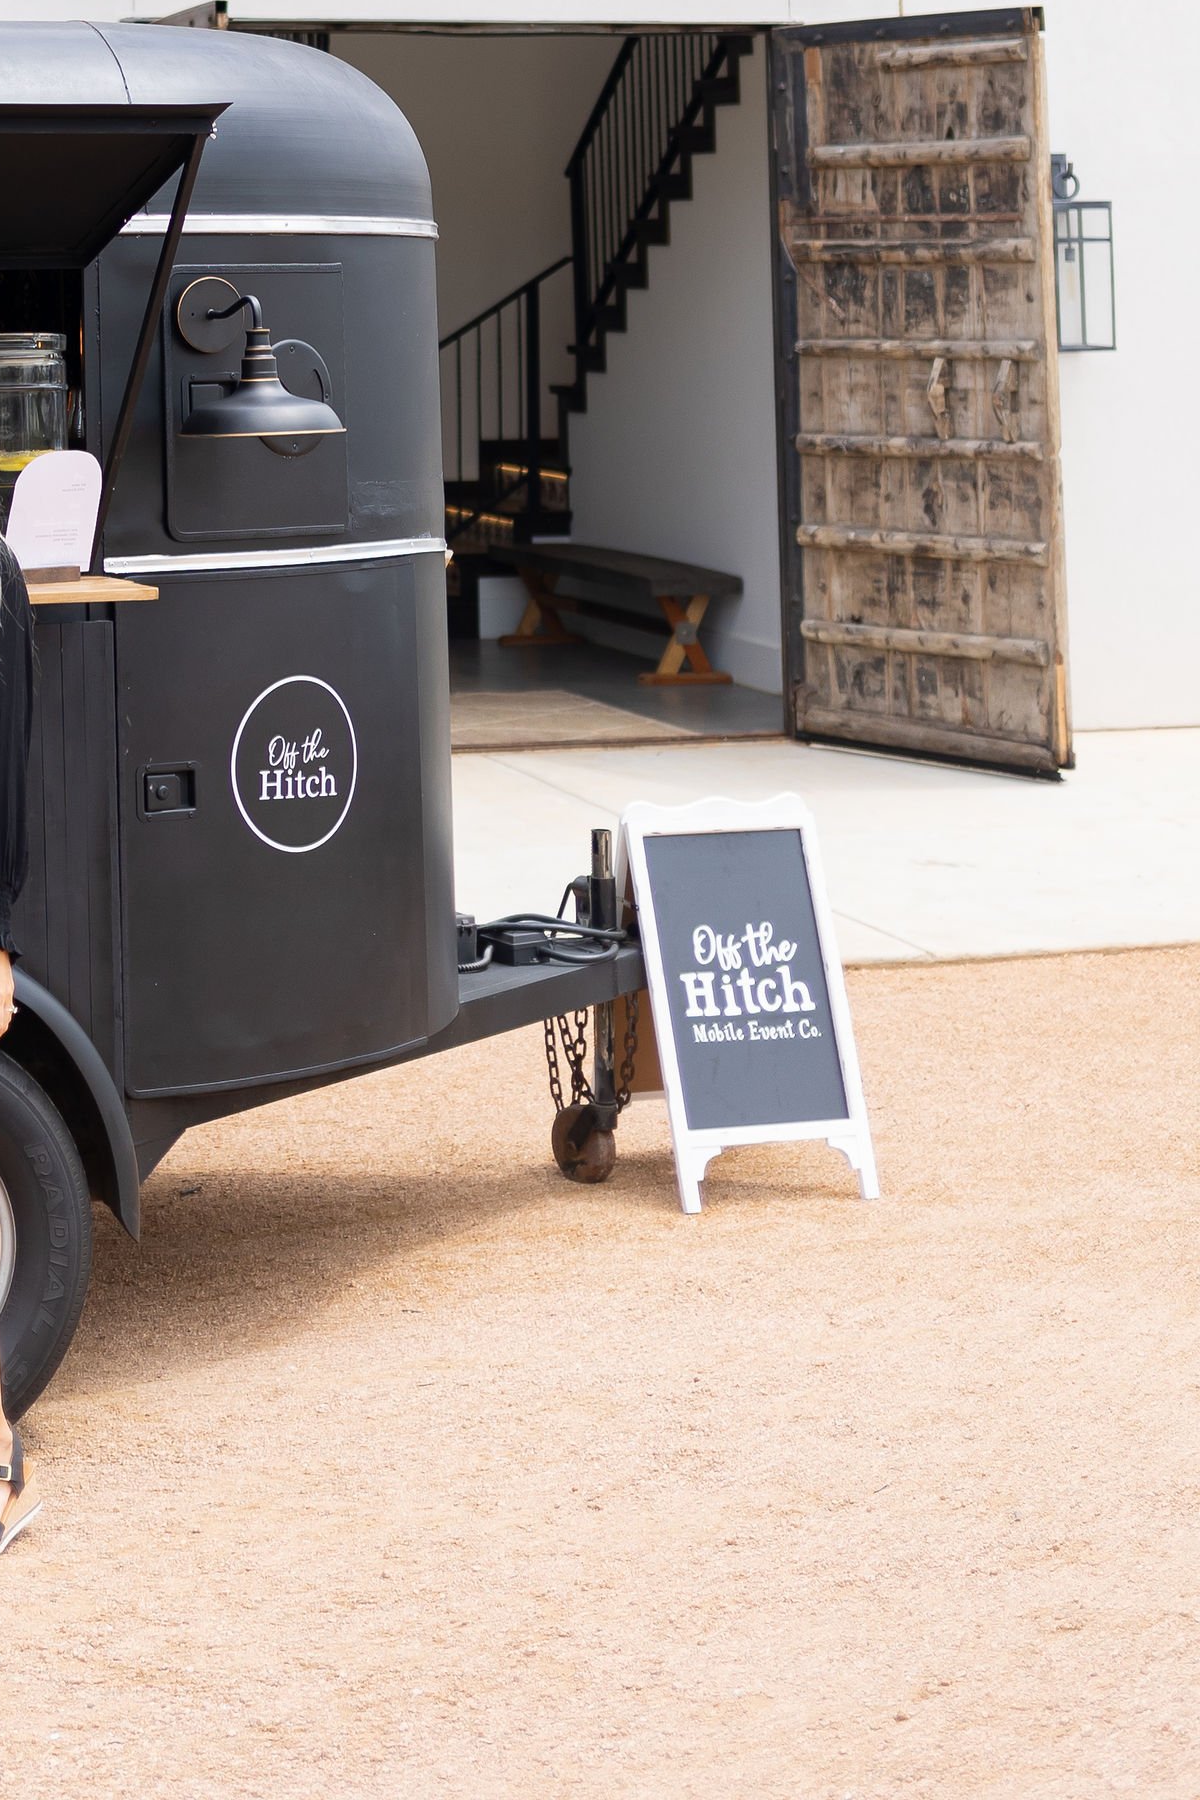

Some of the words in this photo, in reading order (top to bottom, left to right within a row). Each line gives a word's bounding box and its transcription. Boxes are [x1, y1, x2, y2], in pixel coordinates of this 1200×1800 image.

[268, 735, 299, 770] Off
[301, 728, 330, 764] the
[259, 766, 338, 801] Hitch
[692, 924, 743, 971] Off
[741, 921, 798, 968] the
[679, 964, 817, 1018] Hitch
[692, 1021, 745, 1043] Mobile
[748, 1018, 796, 1042] Event
[798, 1018, 823, 1039] Co.
[23, 1143, 70, 1337] RADIAL
